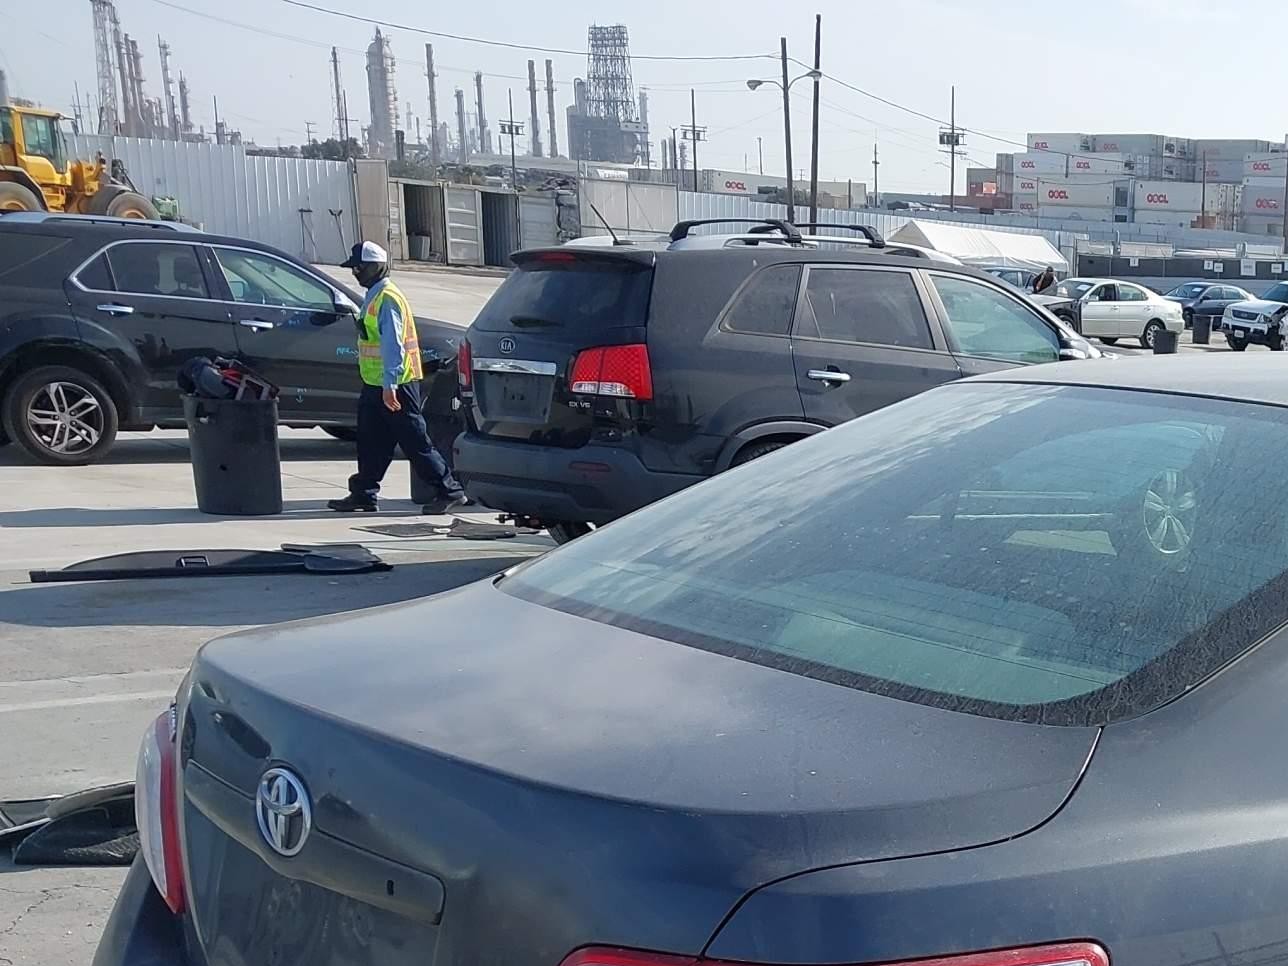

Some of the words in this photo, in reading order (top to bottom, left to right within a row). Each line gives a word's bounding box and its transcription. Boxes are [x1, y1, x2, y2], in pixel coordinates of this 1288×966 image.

[1253, 162, 1271, 170] OOCL
[725, 181, 746, 190] OOCL
[1048, 190, 1069, 199] OOCL
[1147, 193, 1169, 203] OOCL
